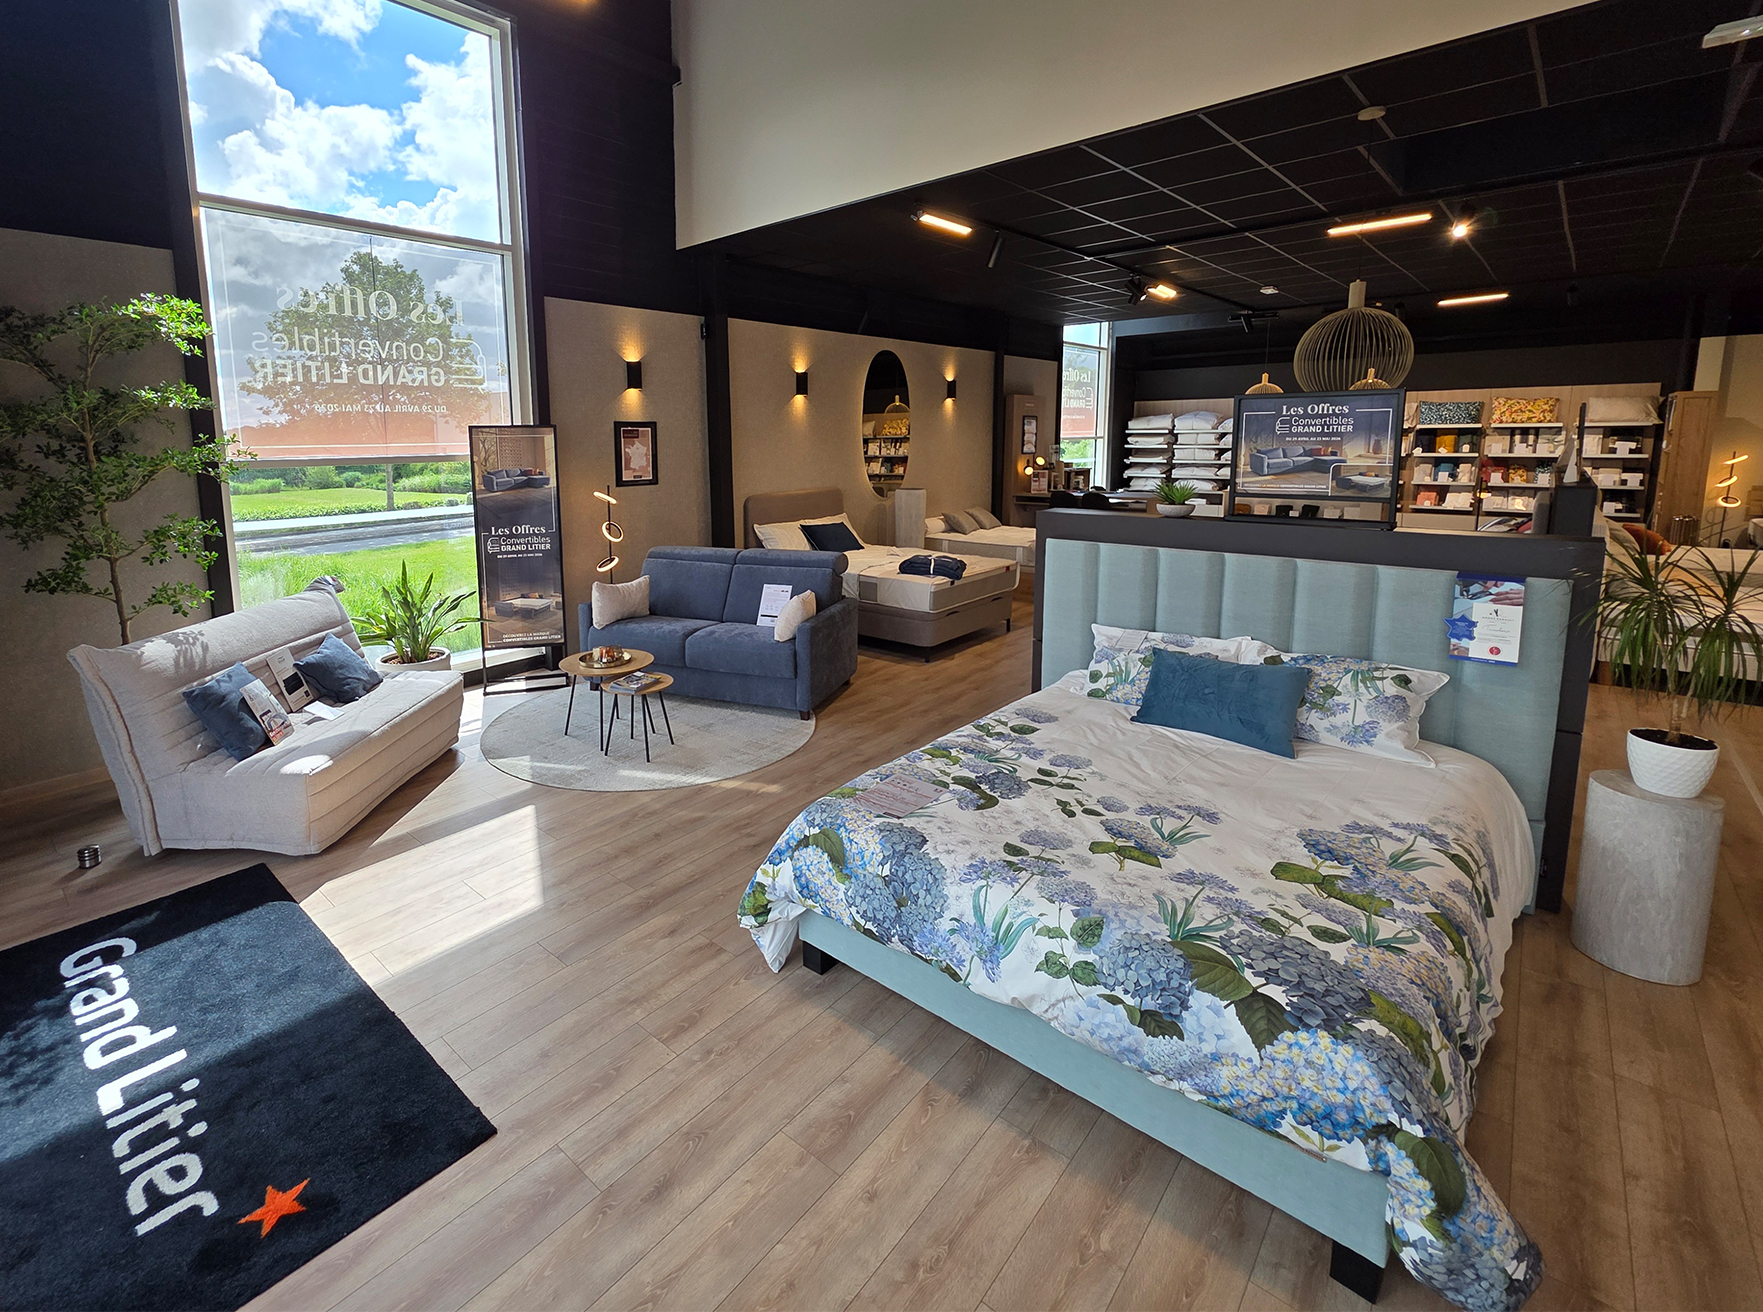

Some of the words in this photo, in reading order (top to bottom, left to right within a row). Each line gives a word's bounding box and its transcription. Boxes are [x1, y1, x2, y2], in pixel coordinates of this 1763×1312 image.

[1282, 405, 1304, 415] Les
[1307, 403, 1350, 415] Offres
[1291, 415, 1354, 425] Convertibles
[491, 526, 510, 535] Les
[512, 524, 546, 534] Offres
[500, 536, 551, 545] Convertibles
[501, 544, 527, 552] GRAND
[528, 543, 551, 551] LITIER
[59, 936, 178, 1070] Grand
[96, 1048, 219, 1237] Litier
